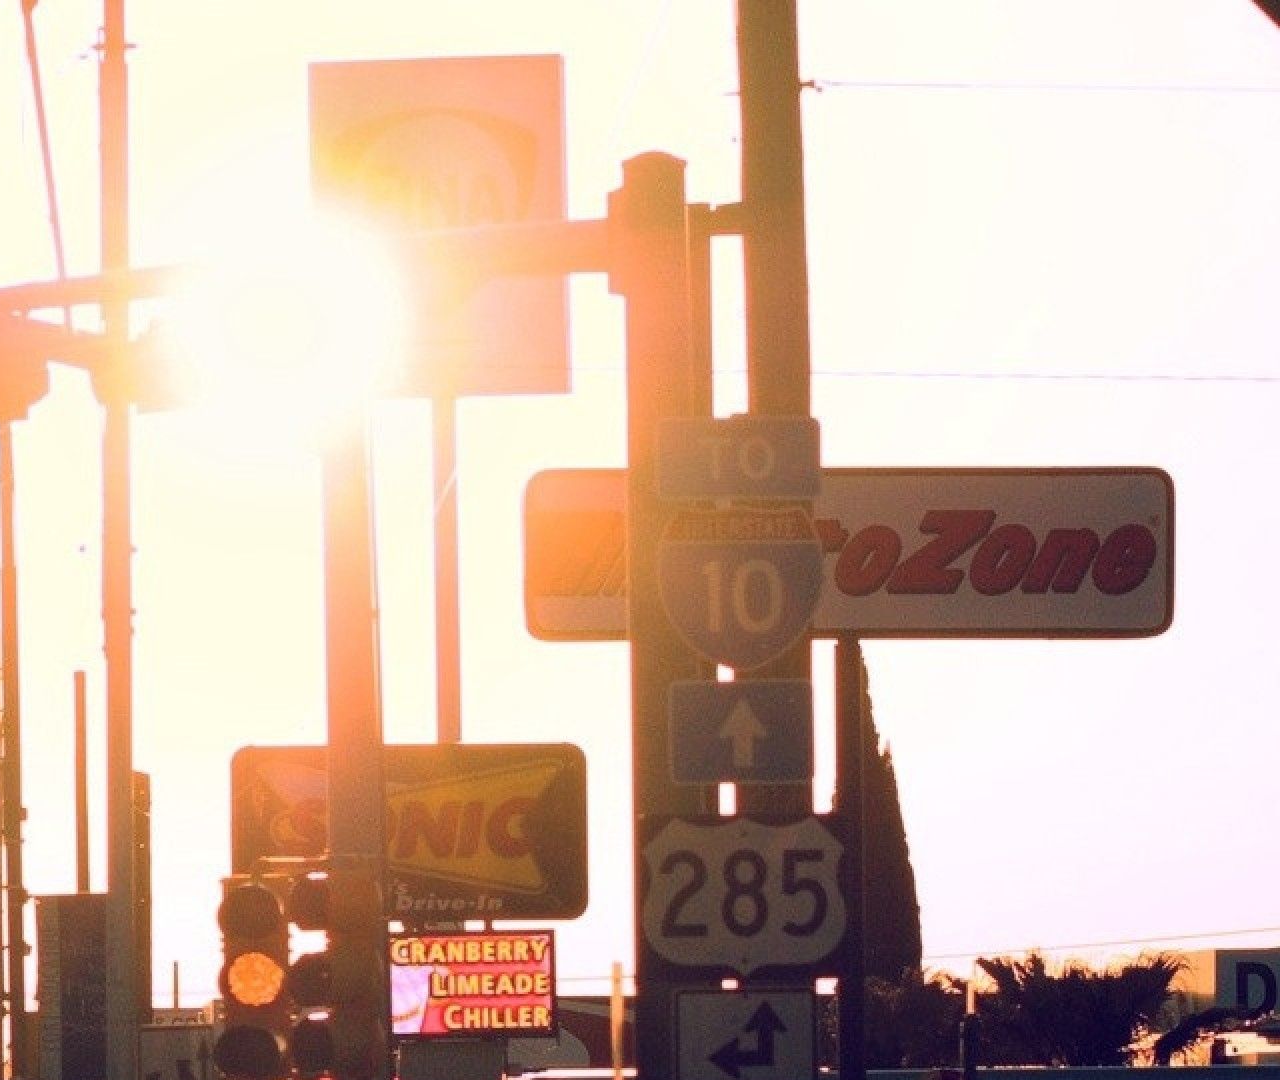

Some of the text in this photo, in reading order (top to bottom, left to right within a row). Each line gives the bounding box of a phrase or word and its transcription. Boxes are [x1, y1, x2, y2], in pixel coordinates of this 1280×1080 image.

[698, 436, 774, 480] TO
[702, 559, 783, 633] 10
[659, 850, 828, 937] 285
[391, 938, 547, 965] CRANBERRY
[431, 973, 550, 999] LIMEADE
[444, 1004, 550, 1029] CHILLER
